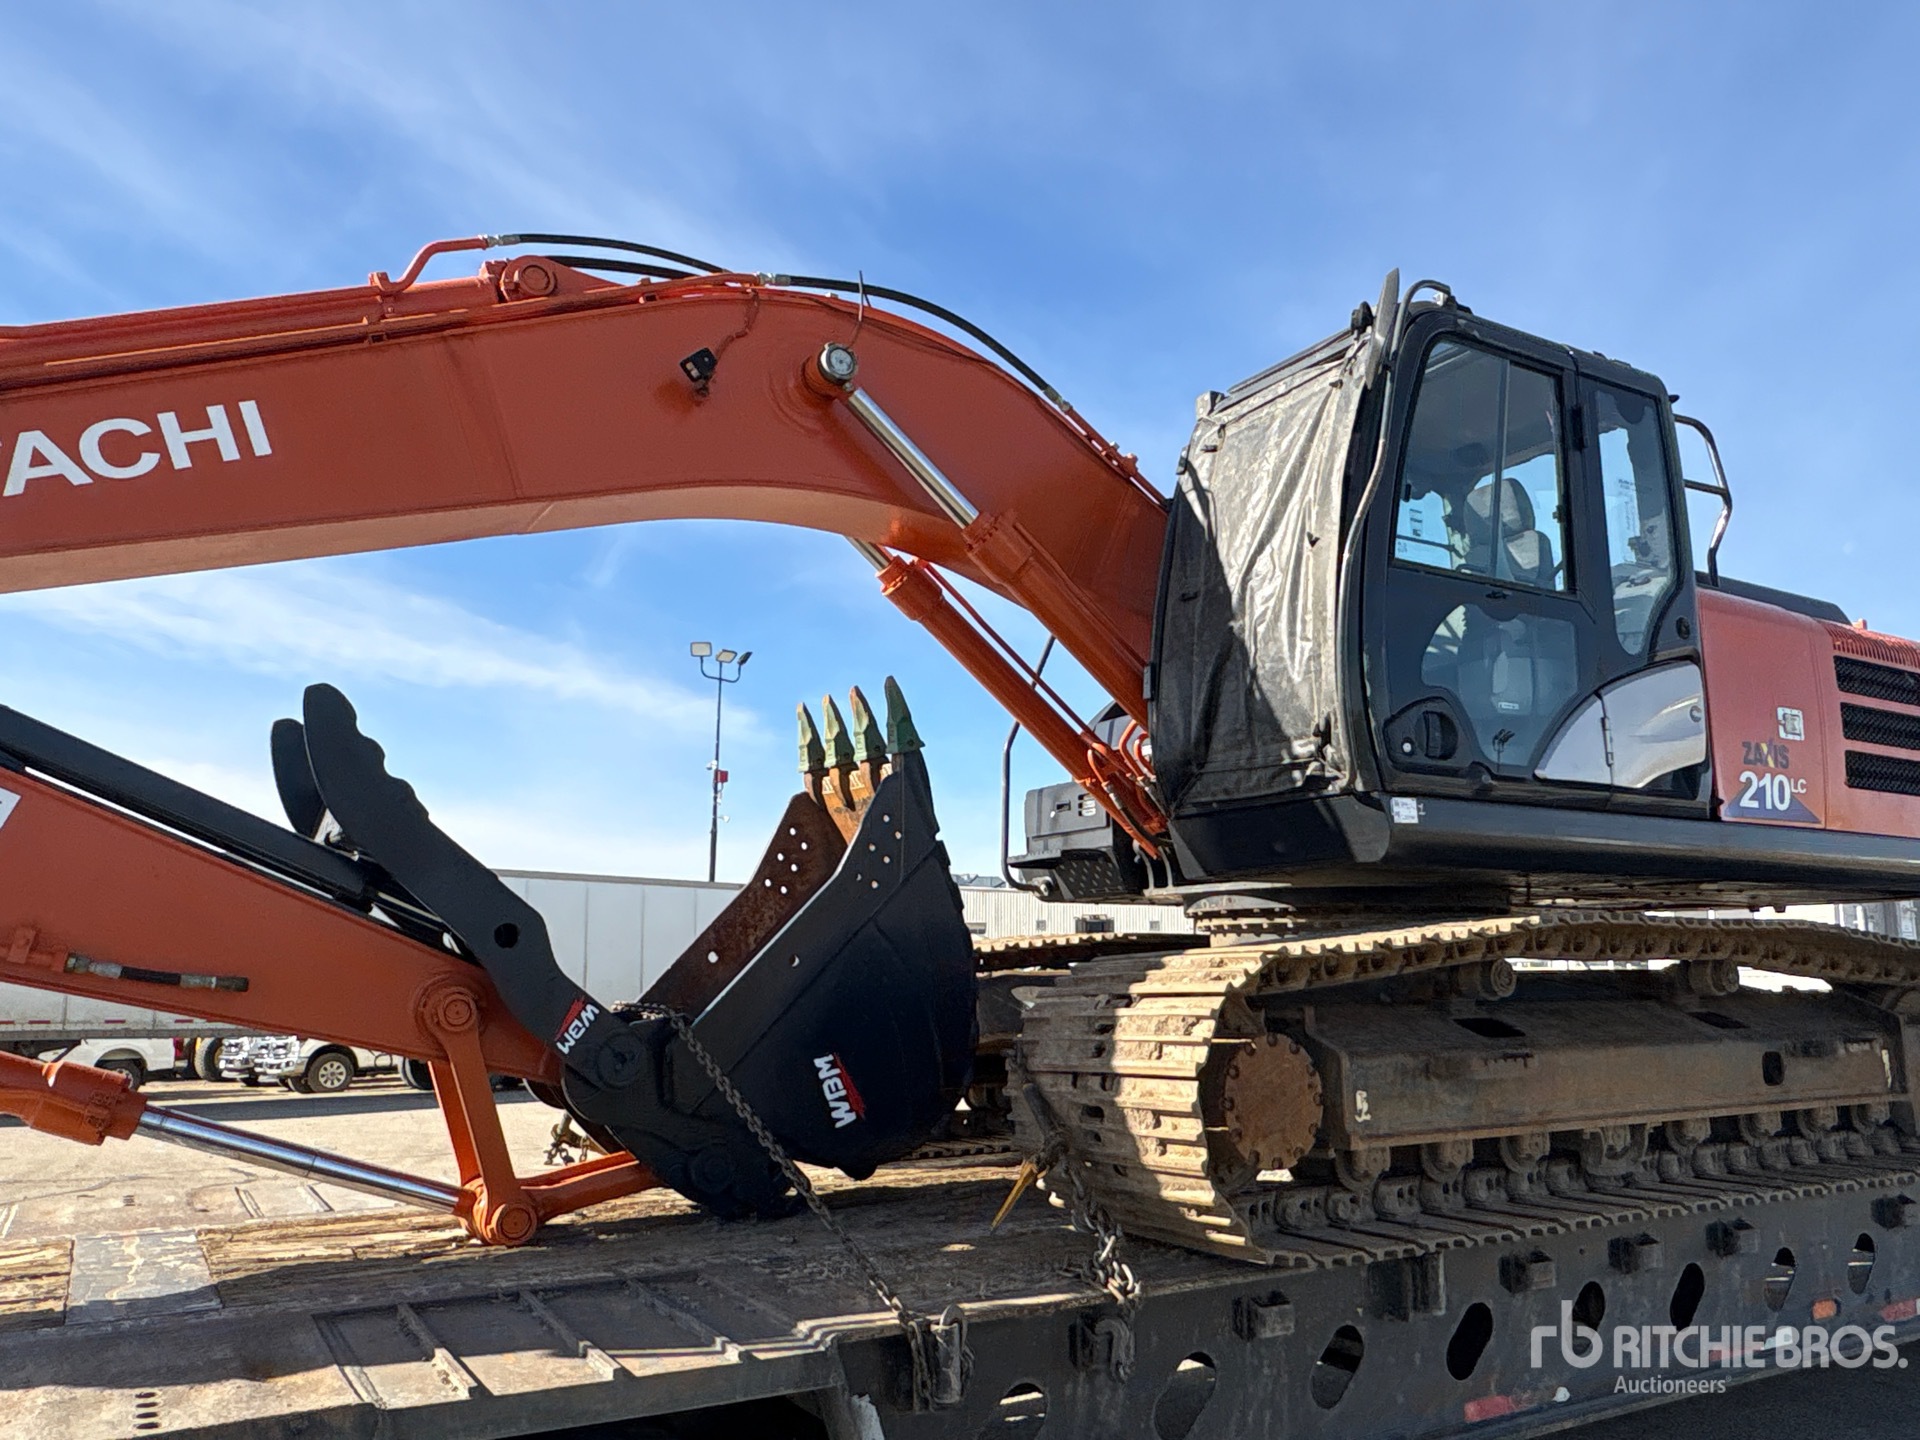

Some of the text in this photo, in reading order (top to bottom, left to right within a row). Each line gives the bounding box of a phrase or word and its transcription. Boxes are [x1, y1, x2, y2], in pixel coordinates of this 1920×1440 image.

[0, 400, 272, 497] ACHI
[1742, 739, 1790, 769] ZAXIS
[556, 1003, 600, 1055] WBM
[813, 1054, 857, 1128] WBM
